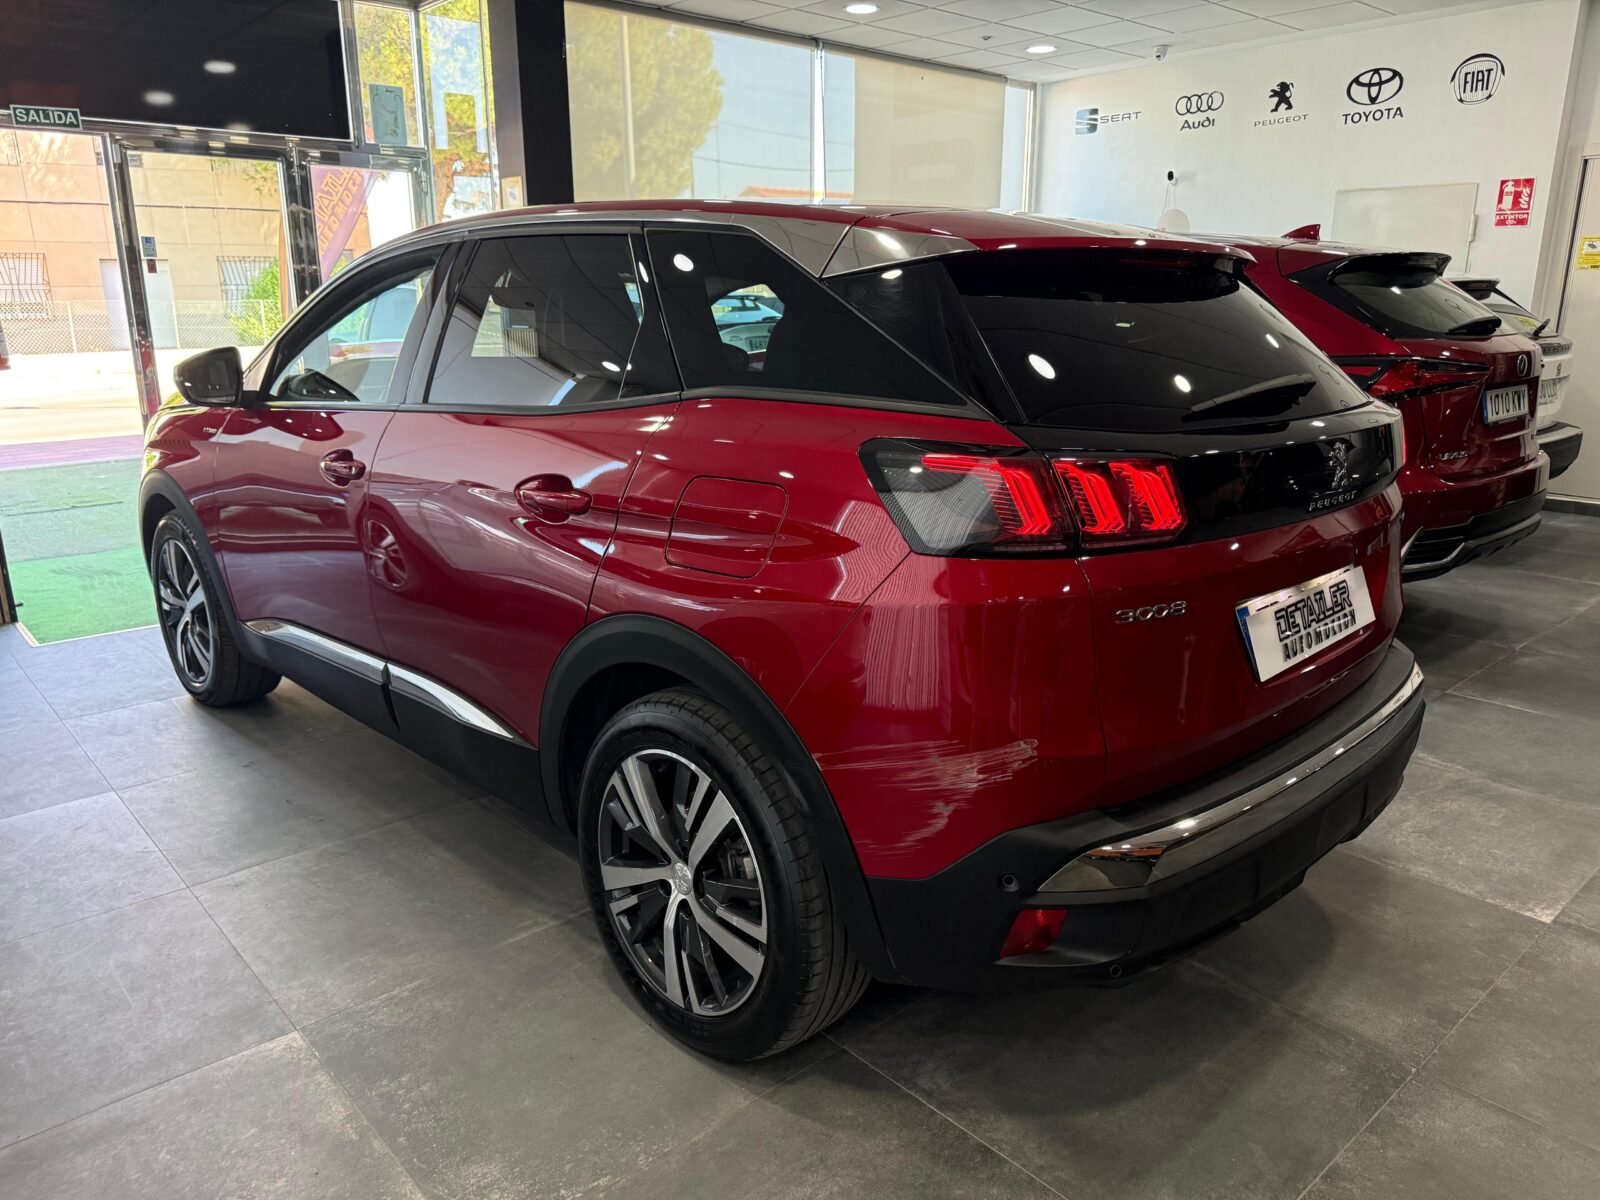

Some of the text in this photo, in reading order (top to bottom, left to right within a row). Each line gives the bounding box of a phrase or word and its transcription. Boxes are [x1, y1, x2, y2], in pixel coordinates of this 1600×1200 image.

[1463, 68, 1494, 94] FIAT
[15, 108, 78, 125] SALIDA
[1100, 111, 1142, 124] SEAT
[1179, 117, 1215, 131] Audi
[1254, 114, 1309, 127] PEUGEOT
[1342, 107, 1404, 125] TOYOTA
[1489, 391, 1510, 417] 1010
[1308, 490, 1357, 512] PEUGEOT
[1114, 600, 1187, 625] 3008
[1274, 579, 1353, 643] DETAILER
